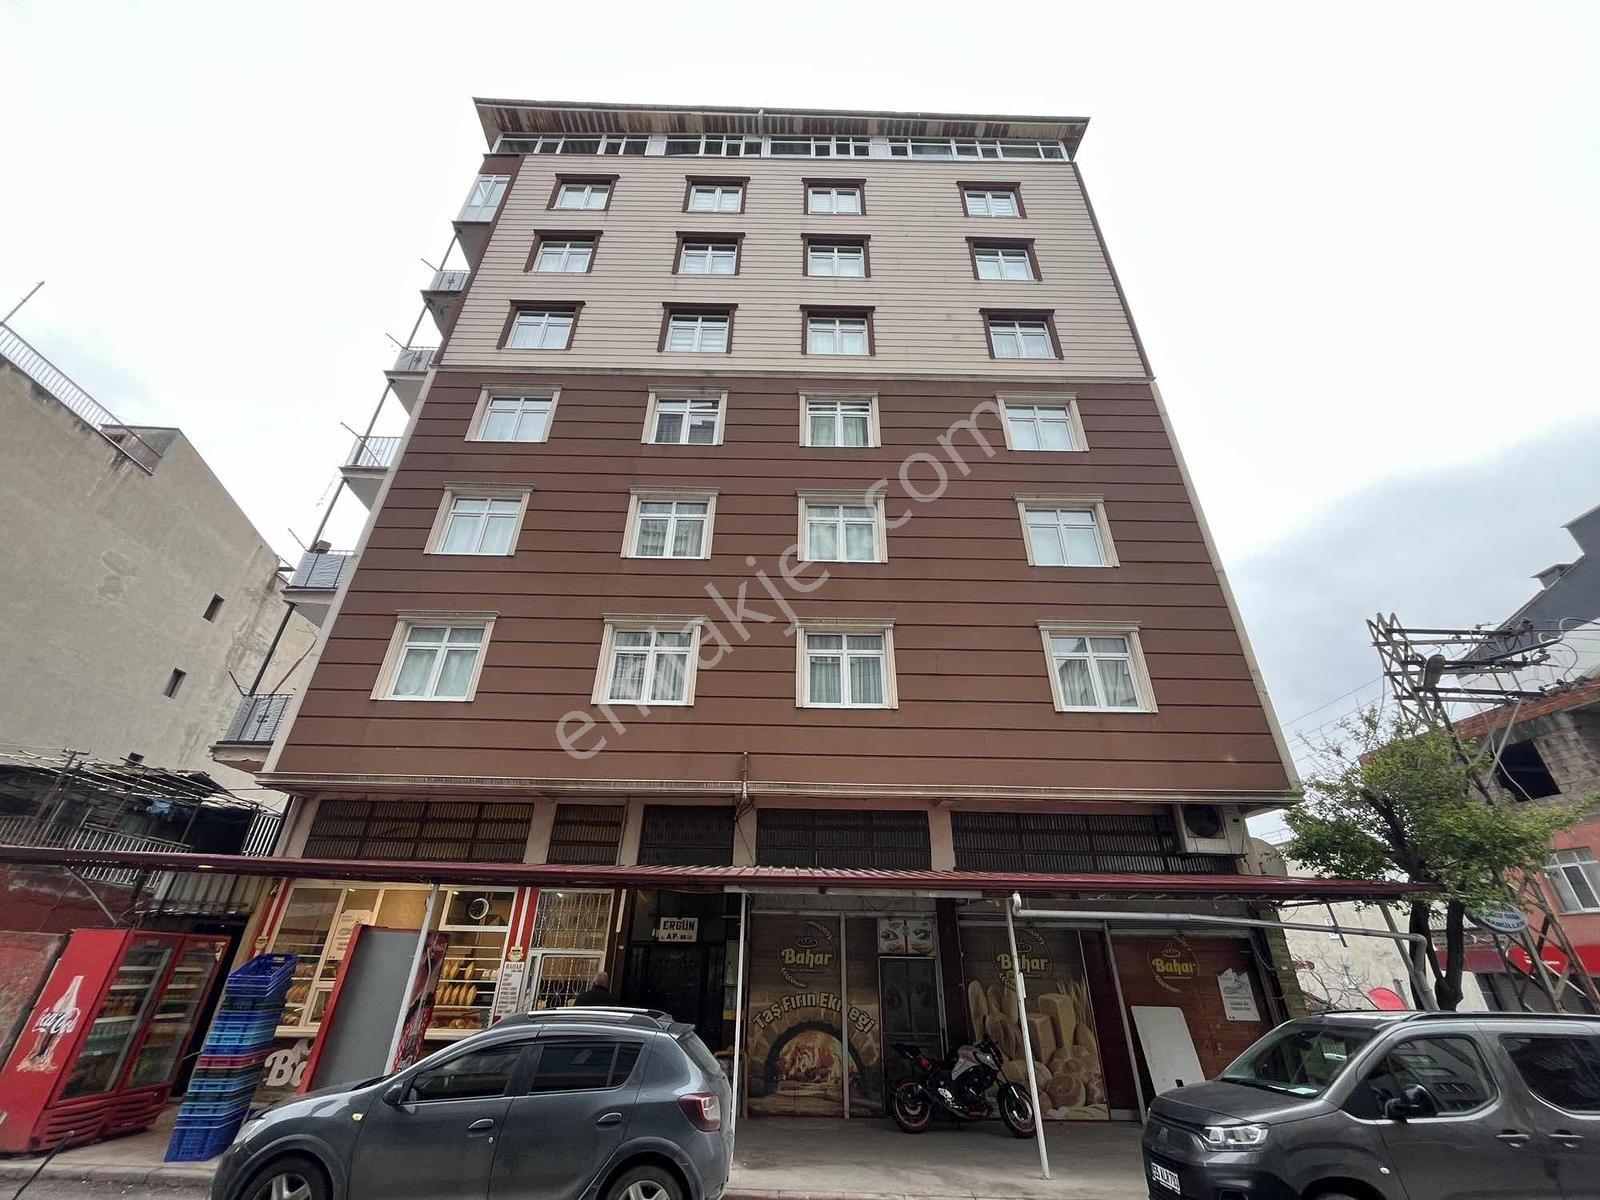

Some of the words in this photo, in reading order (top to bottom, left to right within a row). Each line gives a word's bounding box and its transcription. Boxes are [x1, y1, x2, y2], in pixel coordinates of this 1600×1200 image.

[781, 947, 832, 969] Bahar
[996, 953, 1048, 974] Bhar
[1152, 958, 1196, 975] Bahar
[752, 1002, 782, 1032] Taş
